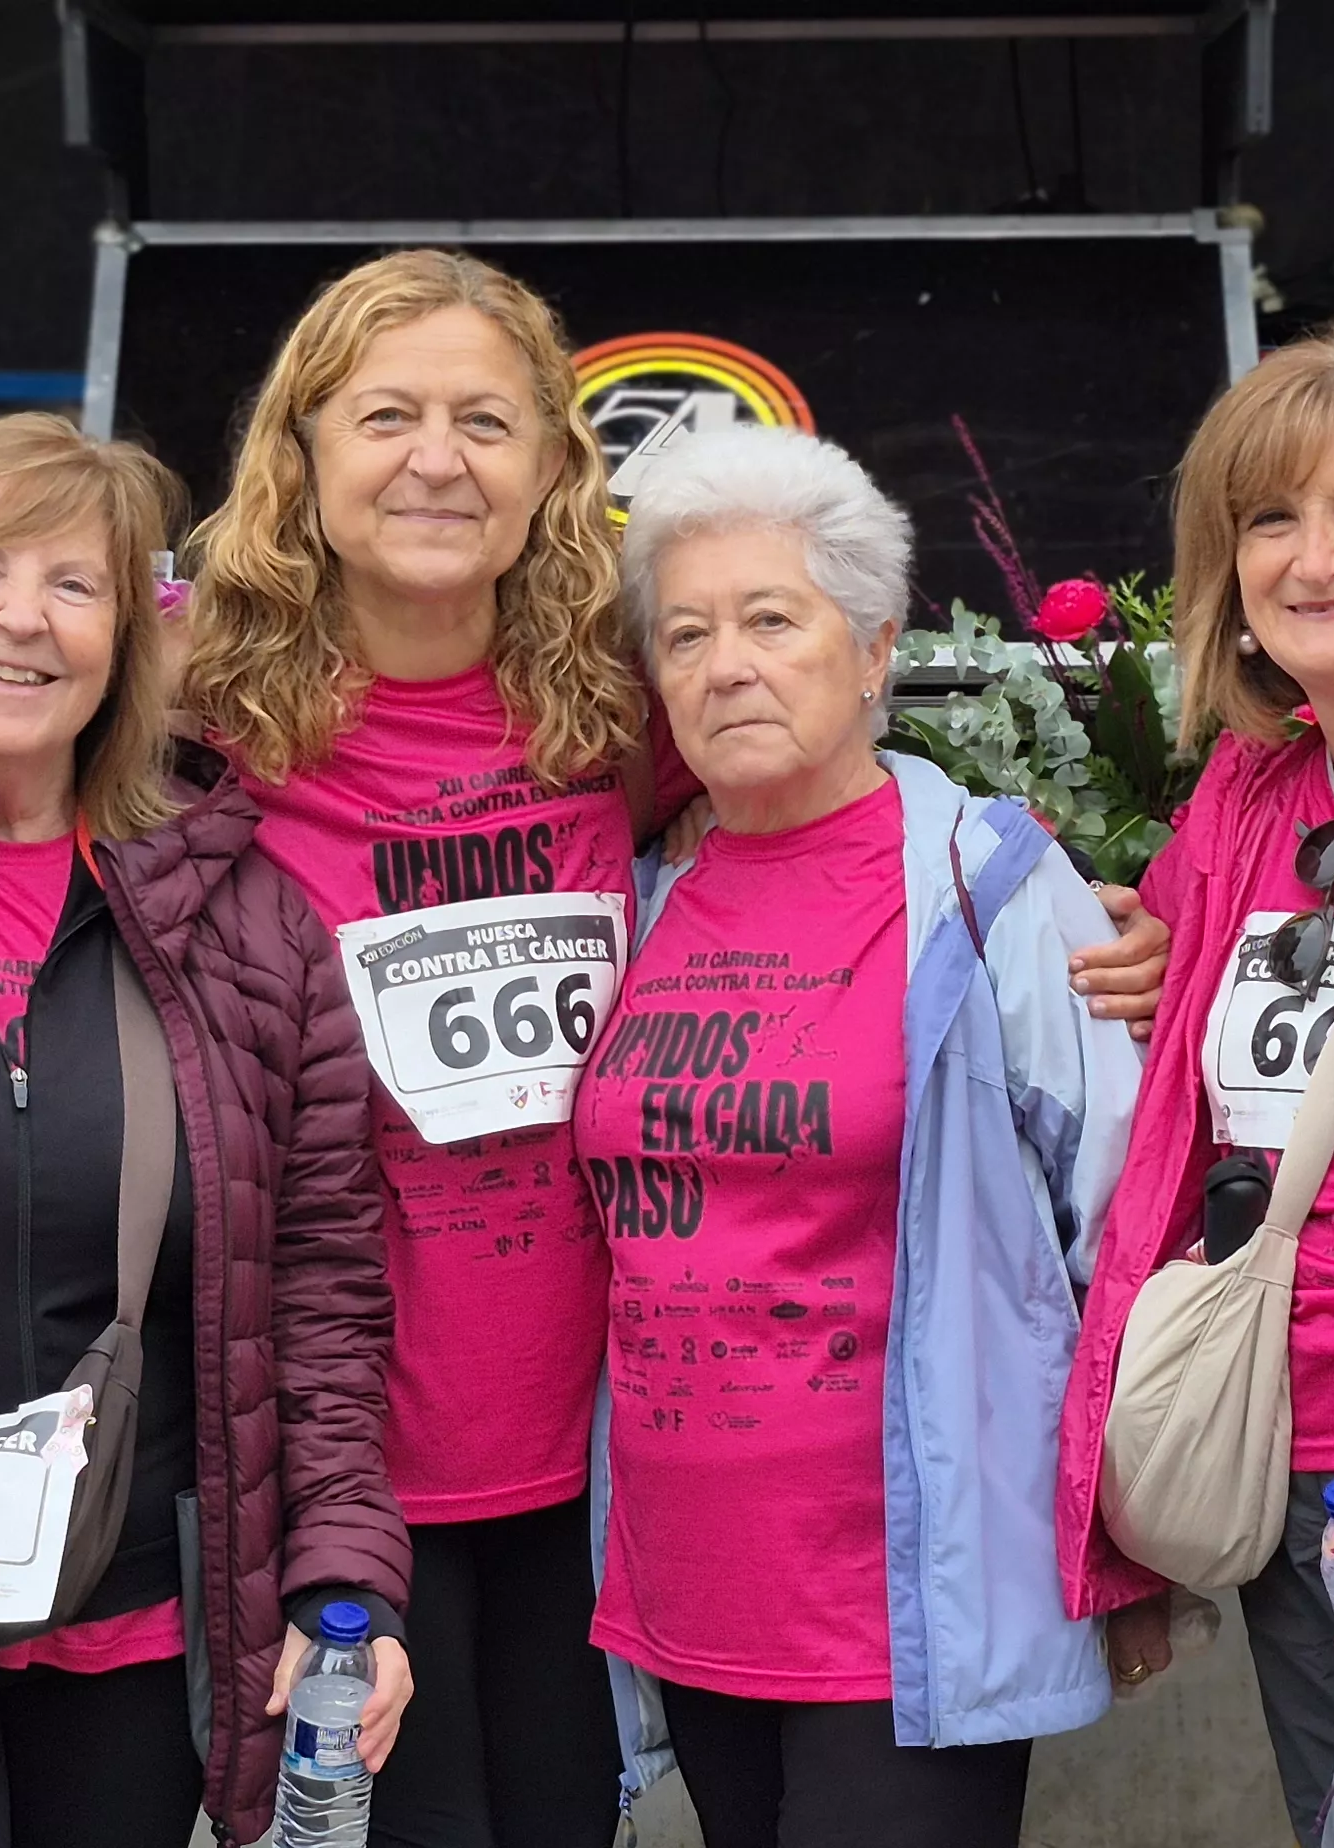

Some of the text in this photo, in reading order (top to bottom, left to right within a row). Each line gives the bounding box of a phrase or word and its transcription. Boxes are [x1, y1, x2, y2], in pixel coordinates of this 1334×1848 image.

[450, 787, 527, 818] CONTRA
[469, 766, 536, 791] CARRE
[372, 821, 555, 913] UNIDOS
[467, 922, 538, 946] HUESCA
[385, 935, 610, 985] CONTRA EL CÁNCER
[685, 950, 791, 969] XII CARRERA
[685, 972, 750, 992] CONTRA
[755, 974, 777, 991] EL
[428, 972, 596, 1070] 666
[596, 1010, 762, 1079] UNIDOS
[641, 1080, 833, 1157] EN CADA
[586, 1156, 704, 1240] PASO
